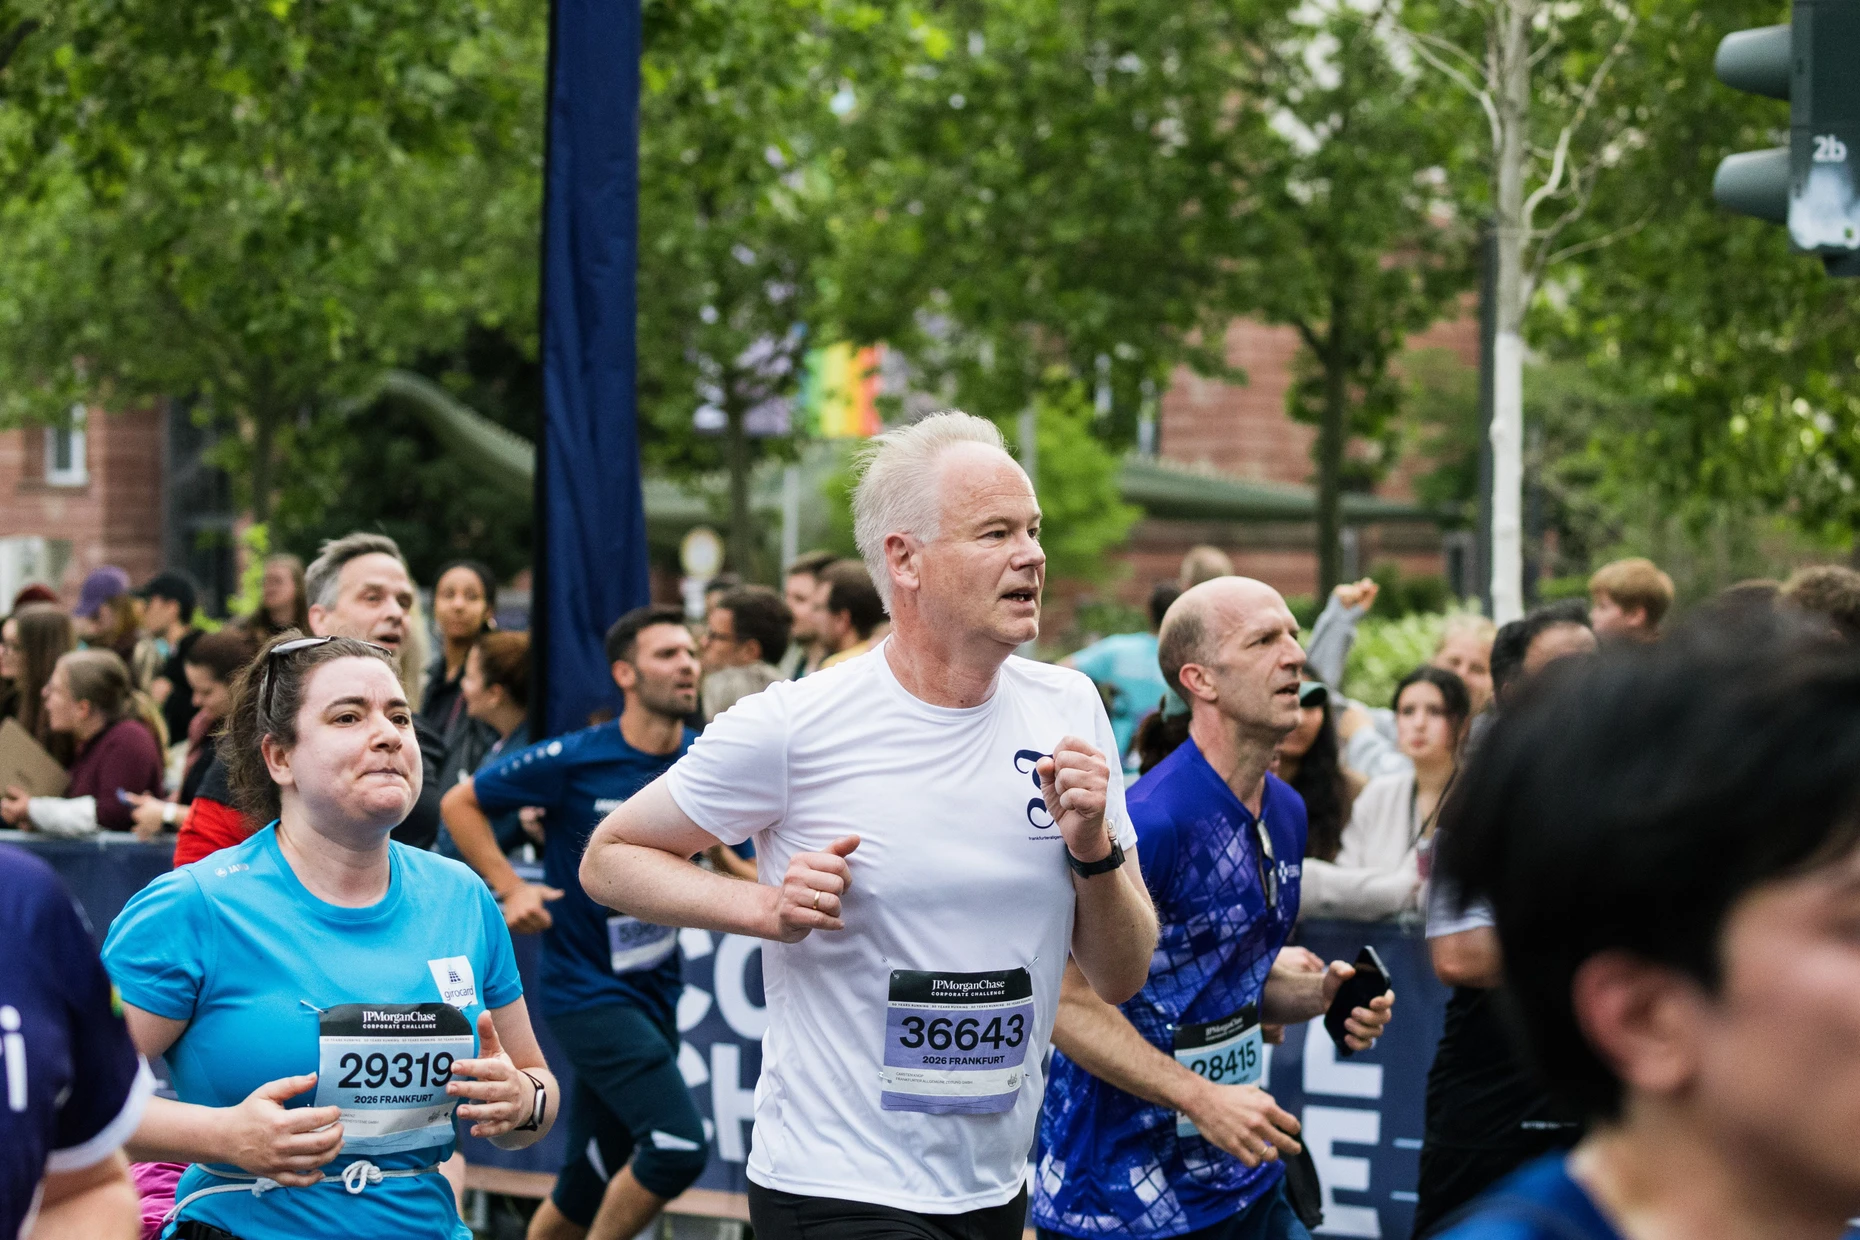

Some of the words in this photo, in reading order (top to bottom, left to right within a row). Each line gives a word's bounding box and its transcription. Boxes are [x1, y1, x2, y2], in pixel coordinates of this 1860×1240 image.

[1812, 134, 1847, 162] 2b
[931, 979, 1006, 992] JPMorganChase
[444, 985, 474, 1001] girocard
[362, 1011, 436, 1023] JPMorganChase
[900, 1013, 1025, 1051] 36643
[922, 1055, 947, 1065] 2026
[949, 1055, 1005, 1065] FRANKFURT
[338, 1051, 454, 1089] 29319
[354, 1095, 378, 1104] 2026
[379, 1093, 434, 1104] FRANKFURT
